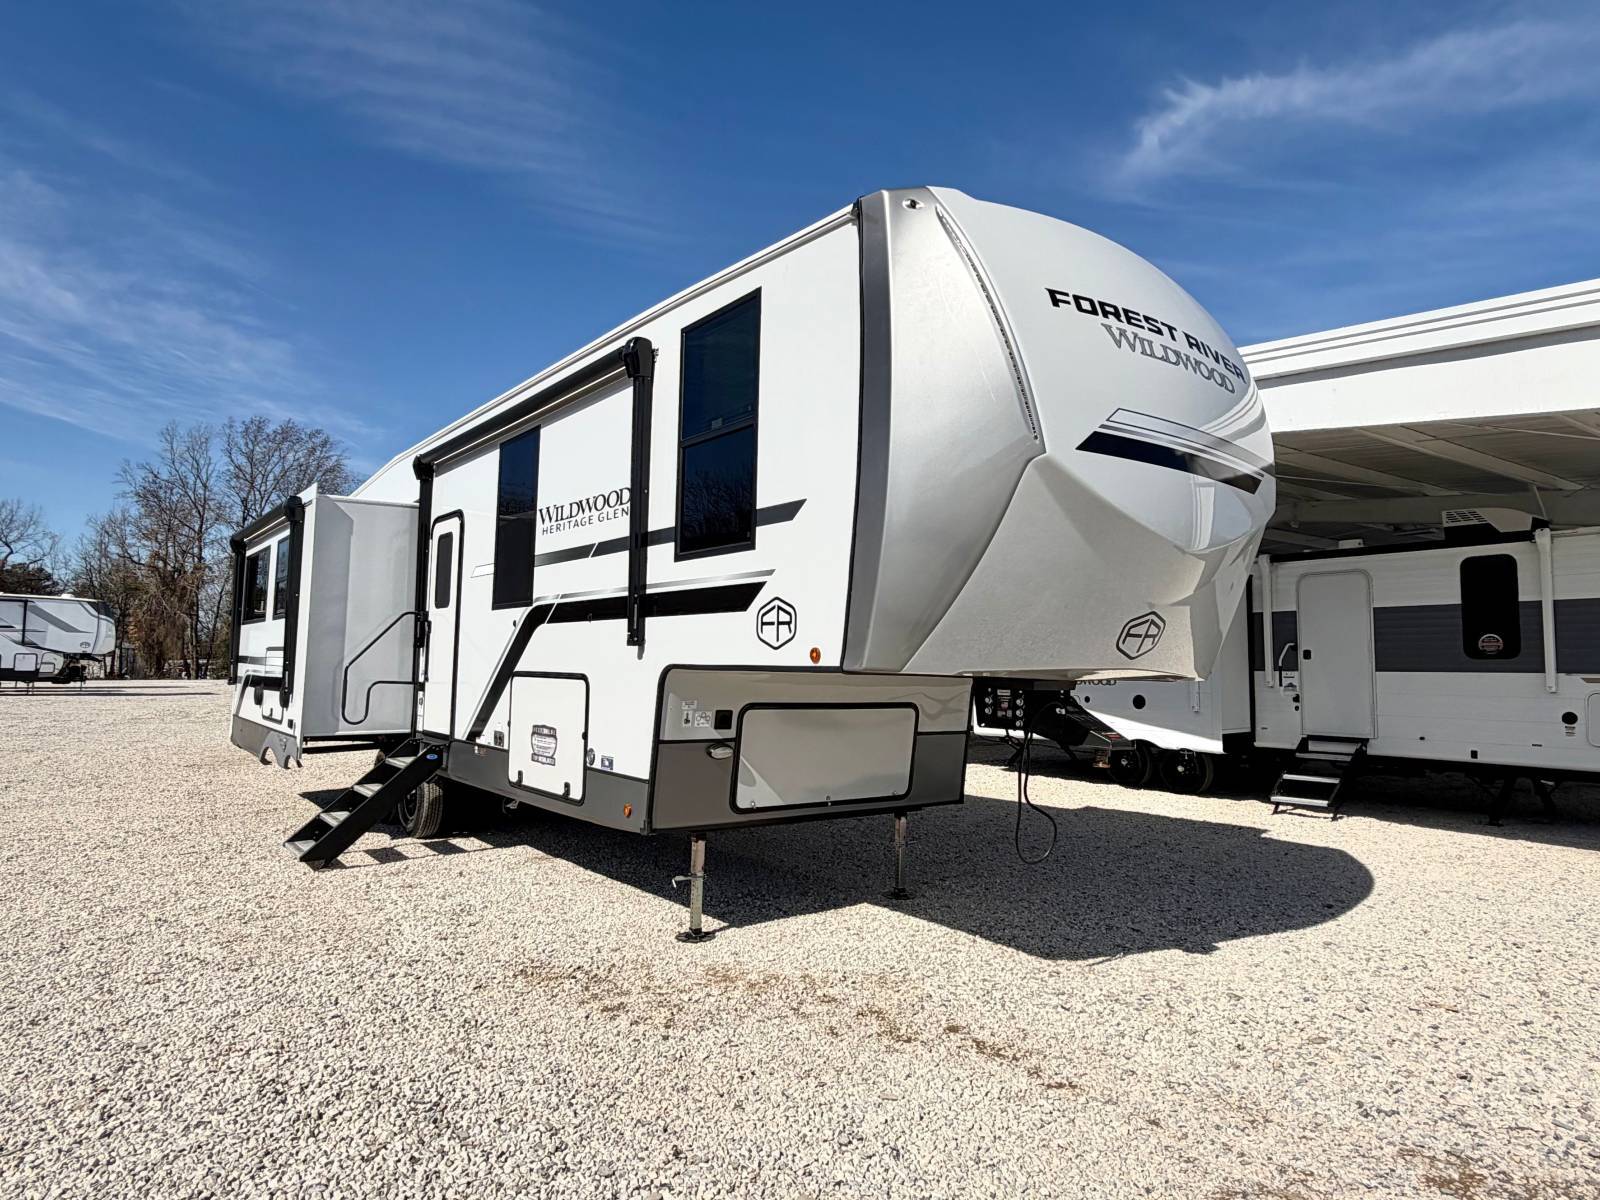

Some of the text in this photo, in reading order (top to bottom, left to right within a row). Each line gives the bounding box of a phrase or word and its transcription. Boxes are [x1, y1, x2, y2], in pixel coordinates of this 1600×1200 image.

[1045, 287, 1248, 384] FOREST RIVER
[1101, 322, 1236, 394] WILDWOOD
[538, 486, 631, 525] WILDWOOD
[541, 506, 630, 536] HERITAGE GLEN
